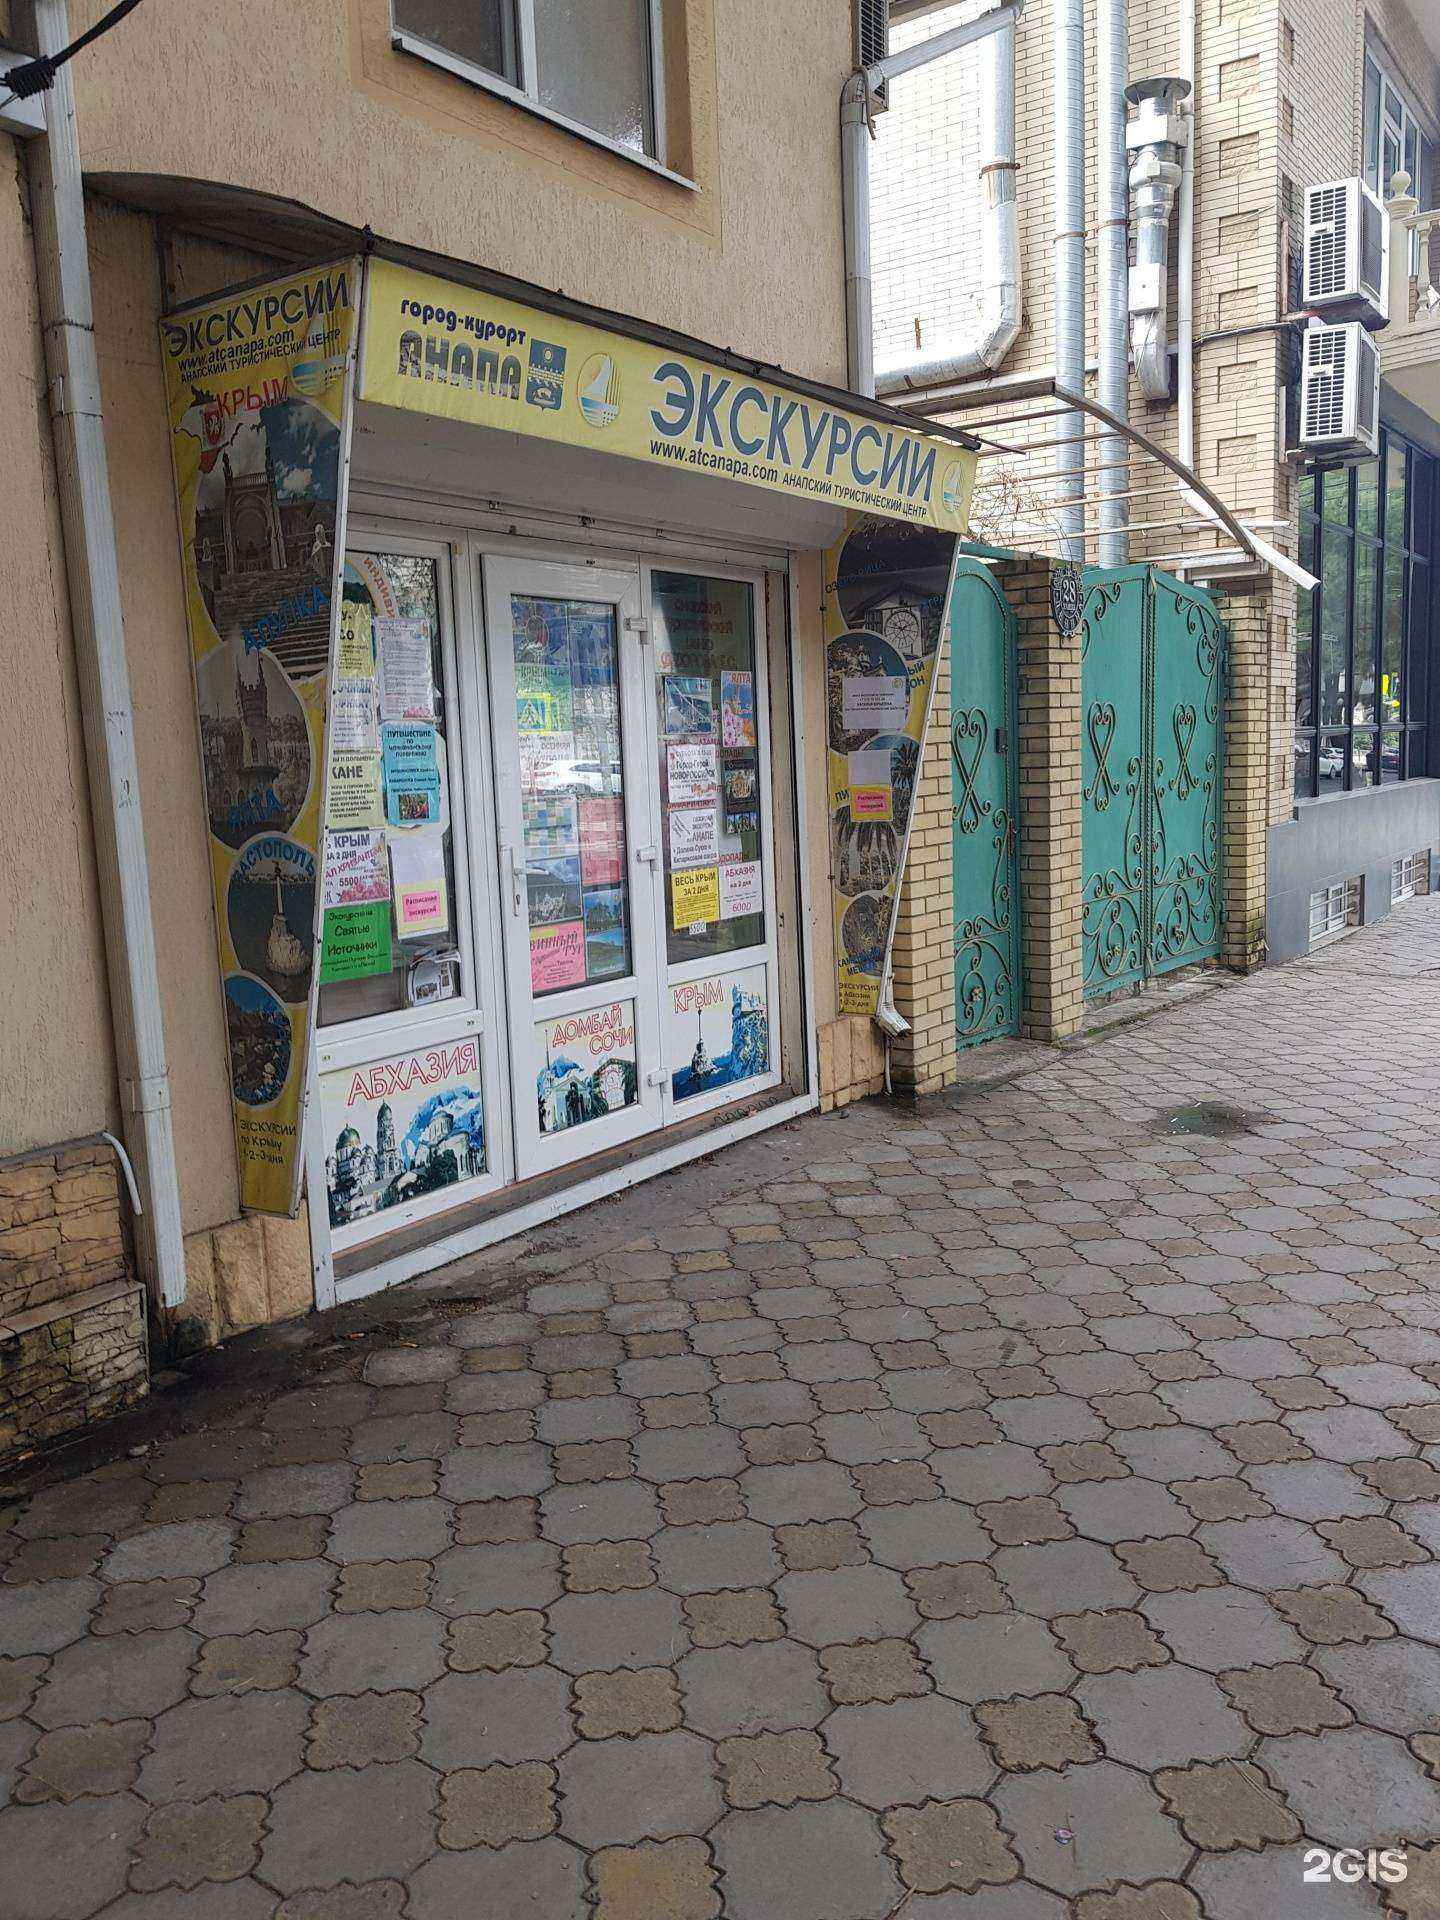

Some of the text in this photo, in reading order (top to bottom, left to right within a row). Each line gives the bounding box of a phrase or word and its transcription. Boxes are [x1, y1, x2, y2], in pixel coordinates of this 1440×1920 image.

[164, 272, 349, 357] ЭКСКУРСИИ
[401, 299, 526, 347] город-курорт
[308, 327, 341, 348] ЦЕНТР
[178, 329, 294, 372] www.atcanapa.com
[399, 330, 522, 400] АНАПА
[216, 376, 288, 418] КРЫМ
[650, 362, 937, 502] ЭКСКУРСИИ
[650, 439, 778, 484] www.atcanapa.com
[782, 472, 927, 519] АНАПСКИЙ ТУРИСТИЧЕСКИЙ ЦЕНТР
[1062, 580, 1077, 602] 28
[334, 833, 372, 848] КРЫМ
[692, 830, 714, 841] АНАПЕ
[342, 850, 357, 860] ДНЯ
[339, 877, 359, 887] 5500
[674, 871, 716, 887] ВЕСЬ КРЫМ
[725, 864, 756, 878] АБХАЗИЯ
[683, 888, 693, 896] ЗА
[697, 884, 709, 895] ДНЯ
[732, 901, 752, 913] 6000
[334, 925, 371, 938] Святые
[674, 979, 724, 1014] КРЫМ
[552, 1004, 623, 1048] ДОМБАЙ
[589, 1026, 633, 1055] СОЧИ
[347, 1042, 477, 1107] АБХАЗИЯ
[239, 1119, 297, 1136] ЭКСКУРСИИ
